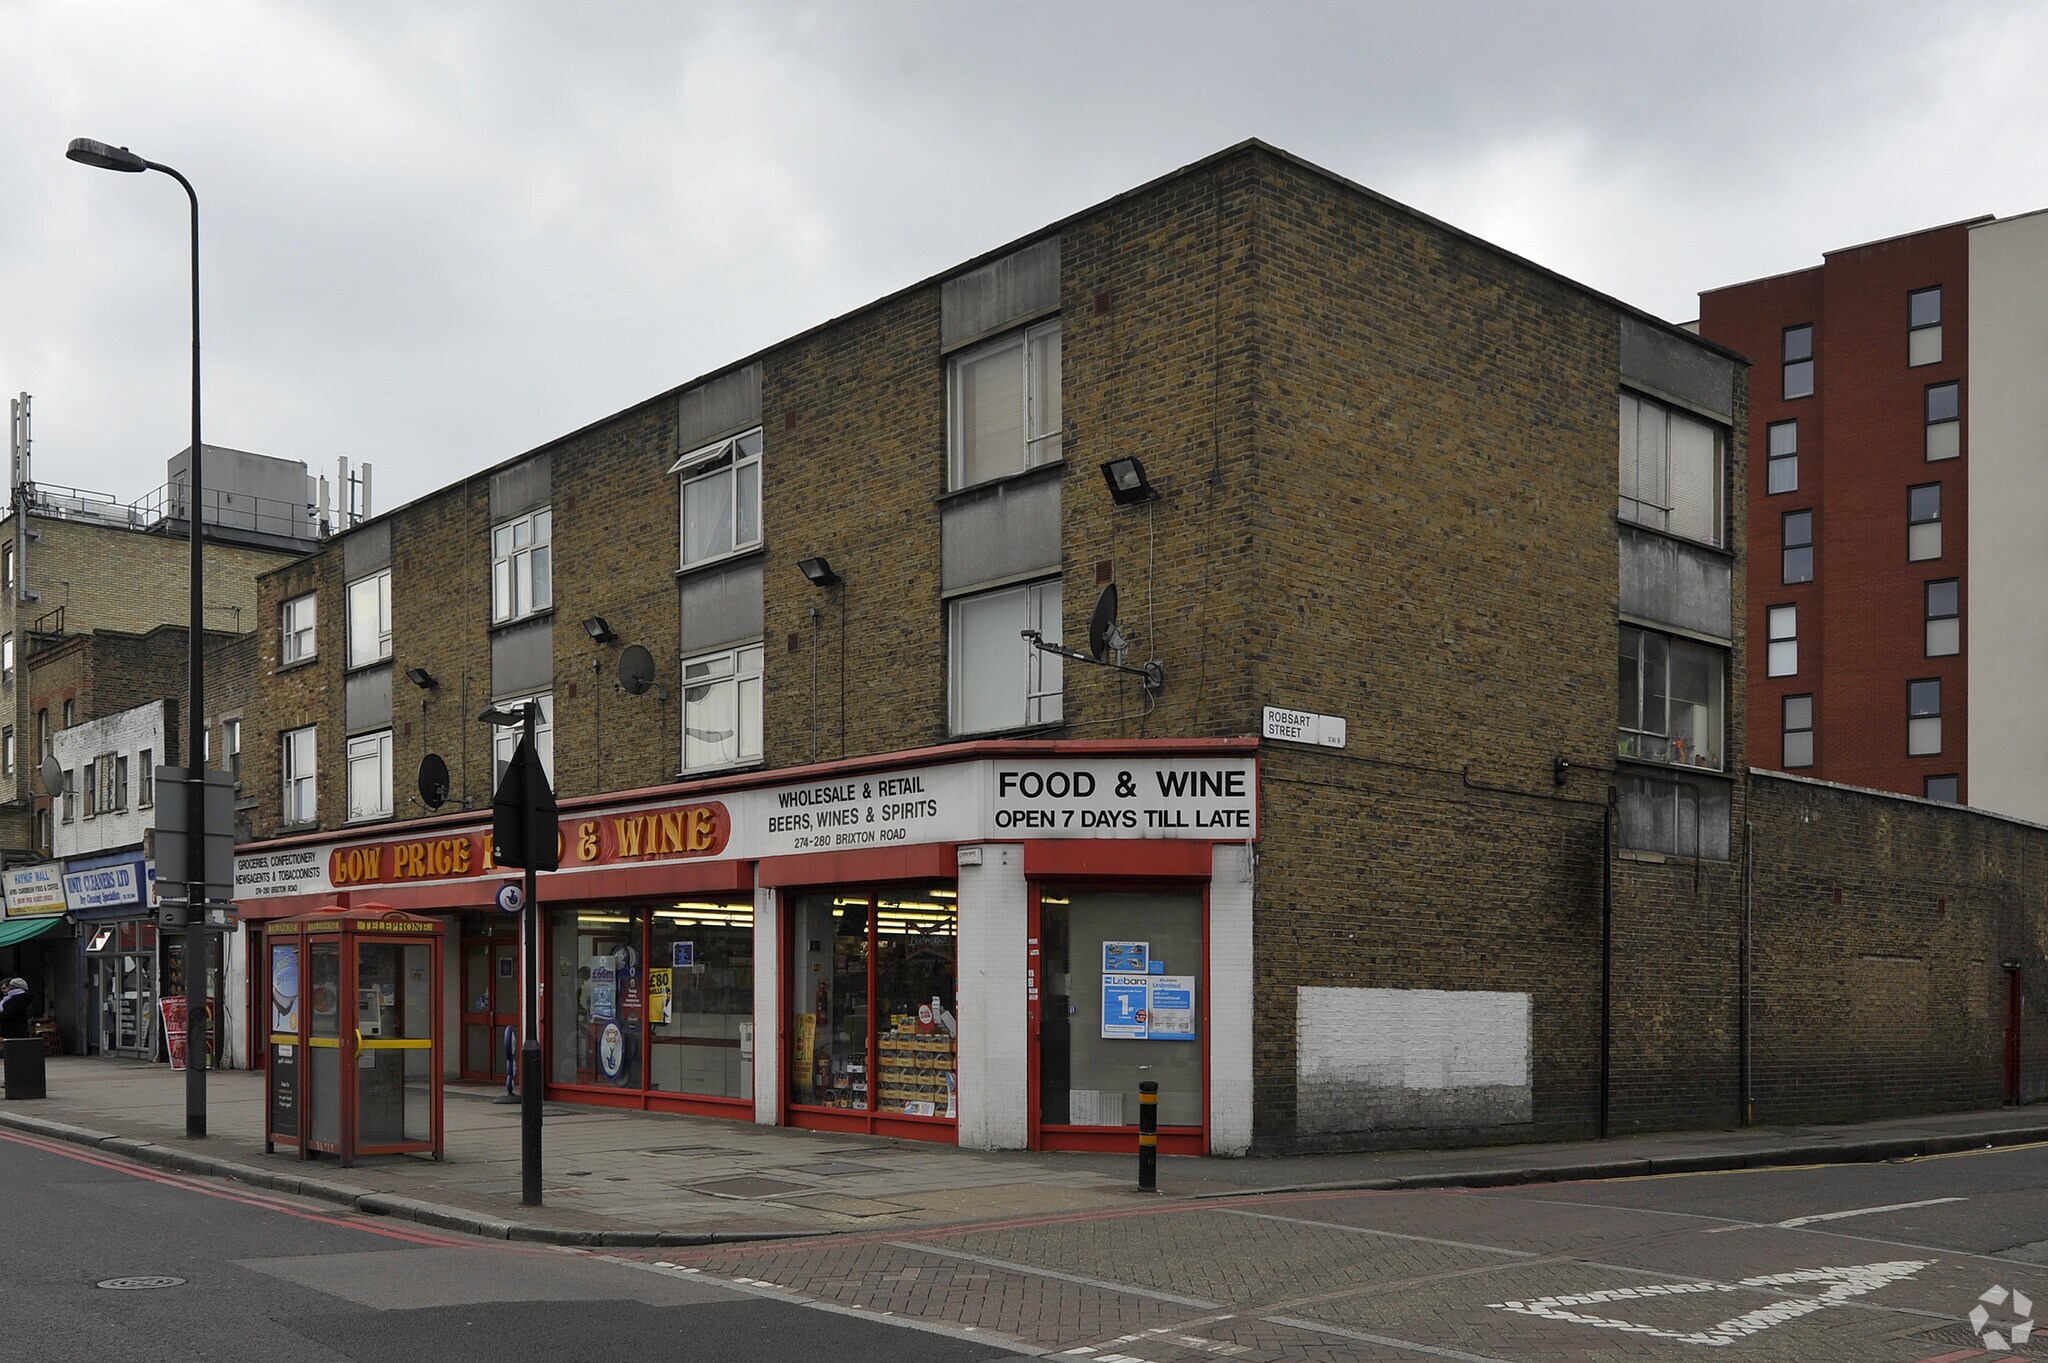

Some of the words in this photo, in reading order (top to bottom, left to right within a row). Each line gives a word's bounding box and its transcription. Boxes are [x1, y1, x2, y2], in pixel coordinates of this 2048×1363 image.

[1268, 711, 1310, 726] ROBSART
[1268, 724, 1301, 738] STREET
[778, 784, 856, 808] WHOLESALE
[862, 782, 871, 799] &
[878, 776, 925, 797] RETAIL
[999, 771, 1096, 798] FOOD
[1114, 770, 1137, 798] &
[1155, 770, 1246, 797] WINE
[768, 813, 813, 833] BEERS,
[816, 808, 859, 827] WINES
[865, 806, 875, 823] &
[882, 799, 937, 821] SPIRITS
[995, 810, 1056, 828] OPEN
[1061, 810, 1075, 828] 7
[1081, 810, 1137, 828] DAYS
[1143, 810, 1189, 828] TILL
[1196, 810, 1250, 828] LATE
[577, 821, 599, 862] &
[614, 807, 717, 857] WINE
[794, 835, 831, 848] 274-280
[836, 831, 875, 845] BRIXTON
[880, 828, 906, 841] ROAD
[238, 857, 269, 870] GROCERIES,
[270, 851, 316, 867] CONFECTIONERY
[334, 847, 383, 884] LOW
[393, 837, 472, 878] PRICE
[83, 871, 115, 891] CLEANERS
[115, 869, 130, 888] LTD
[235, 872, 270, 885] NEWSAGENTS
[272, 871, 276, 881] &
[278, 866, 320, 881] TOBACCONISTS
[87, 892, 101, 904] Cleaning
[102, 891, 120, 903] Specialists
[363, 921, 429, 931] TELEPHONE
[1112, 976, 1147, 985] Lebara
